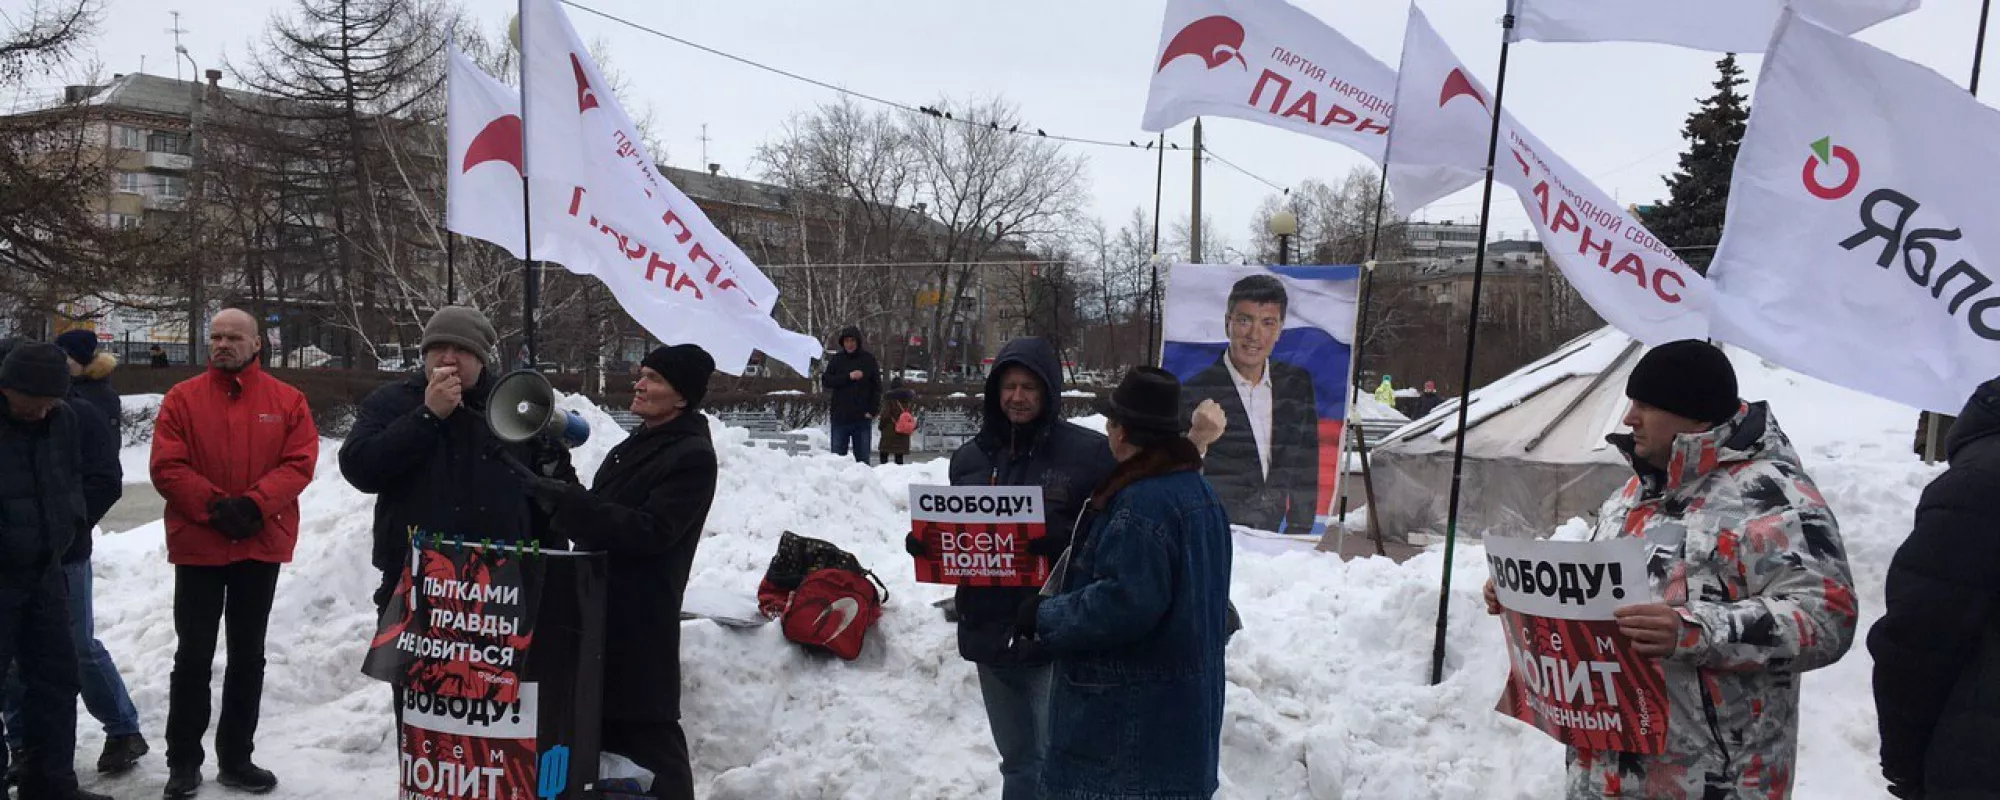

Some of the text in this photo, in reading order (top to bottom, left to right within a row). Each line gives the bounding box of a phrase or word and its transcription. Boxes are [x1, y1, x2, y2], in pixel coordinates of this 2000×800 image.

[1271, 46, 1327, 82] ПАРТИЯ
[919, 494, 1033, 517] СВОБОДУ!
[941, 552, 1015, 568] ПОЛИТ
[422, 576, 519, 605] ПЫТКАМИ
[1487, 553, 1626, 606] ВОБОДУ!
[430, 608, 519, 636] ПРАВДЫ
[403, 686, 521, 727] ВОБОДУ!
